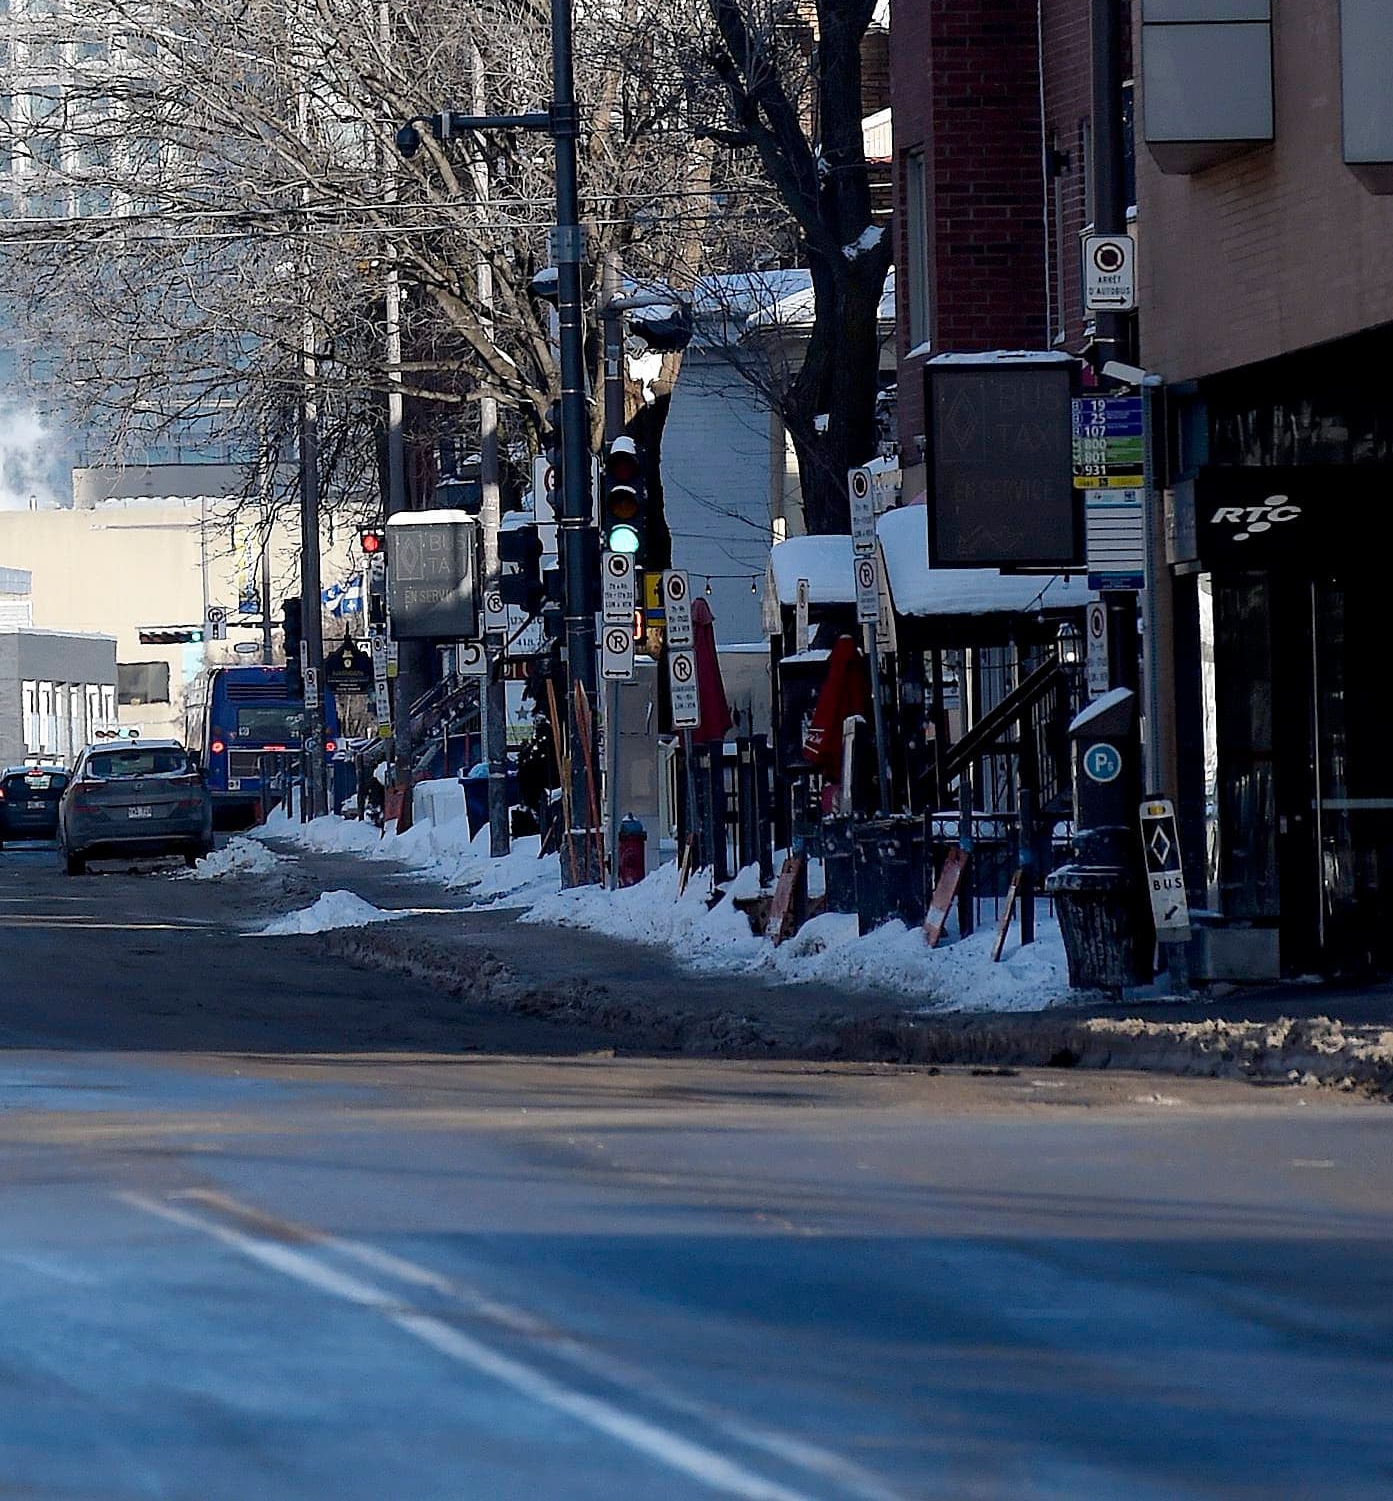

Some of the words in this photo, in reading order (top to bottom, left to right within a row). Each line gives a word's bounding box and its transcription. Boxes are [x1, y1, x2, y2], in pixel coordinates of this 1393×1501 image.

[1090, 399, 1106, 411] 19
[1090, 412, 1106, 424] 25
[1084, 425, 1106, 437] 107
[1084, 438, 1106, 450] 800
[1084, 451, 1106, 462] 801
[1084, 464, 1106, 476] 931
[1210, 506, 1302, 524] RTC
[1153, 877, 1182, 891] BUS
